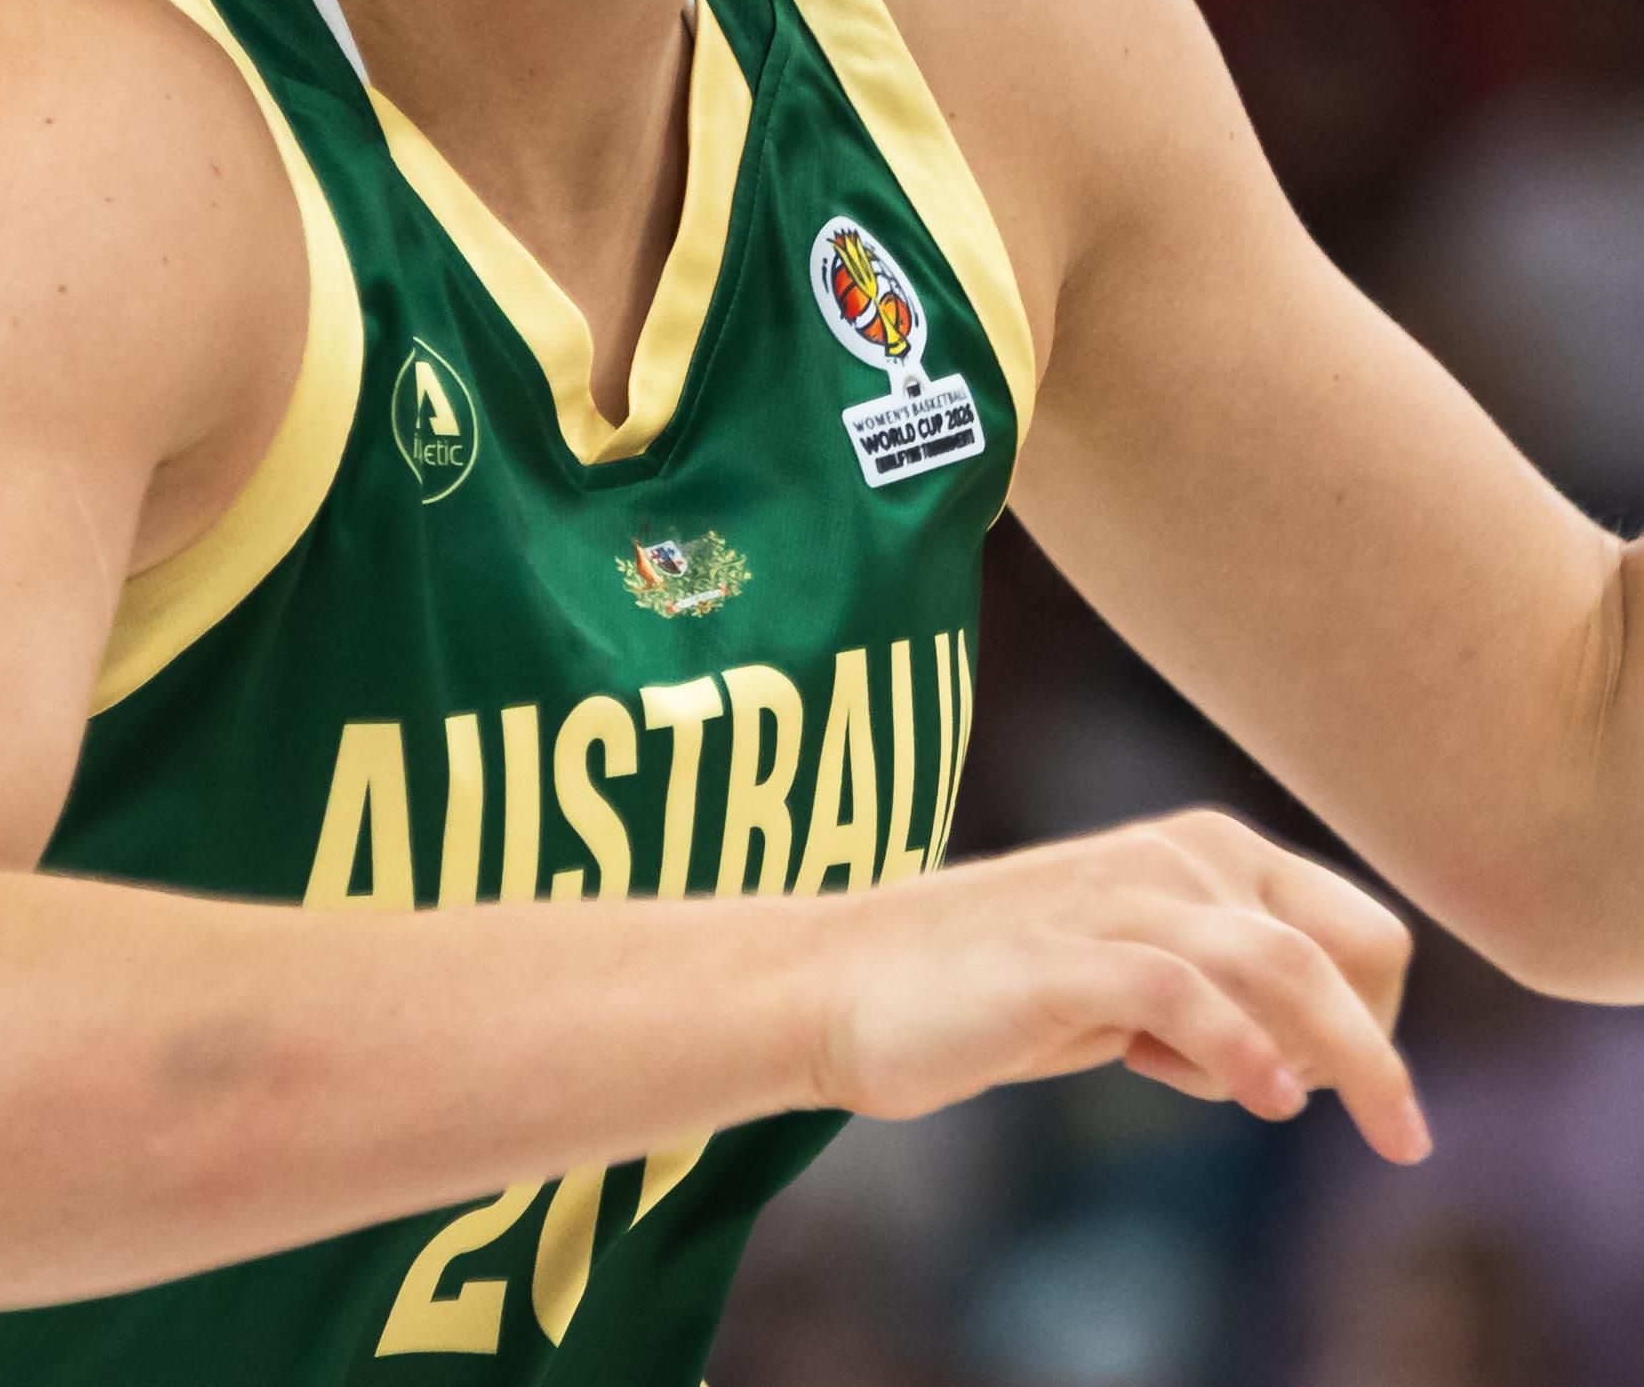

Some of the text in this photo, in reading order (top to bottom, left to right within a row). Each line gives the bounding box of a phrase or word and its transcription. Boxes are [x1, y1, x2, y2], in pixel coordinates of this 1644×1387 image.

[853, 405, 910, 432] WOMEN'S
[912, 388, 967, 417] BASKETBALL
[860, 423, 916, 455] WORLD
[917, 413, 943, 439] CUP
[302, 628, 973, 912] AUSTRALI
